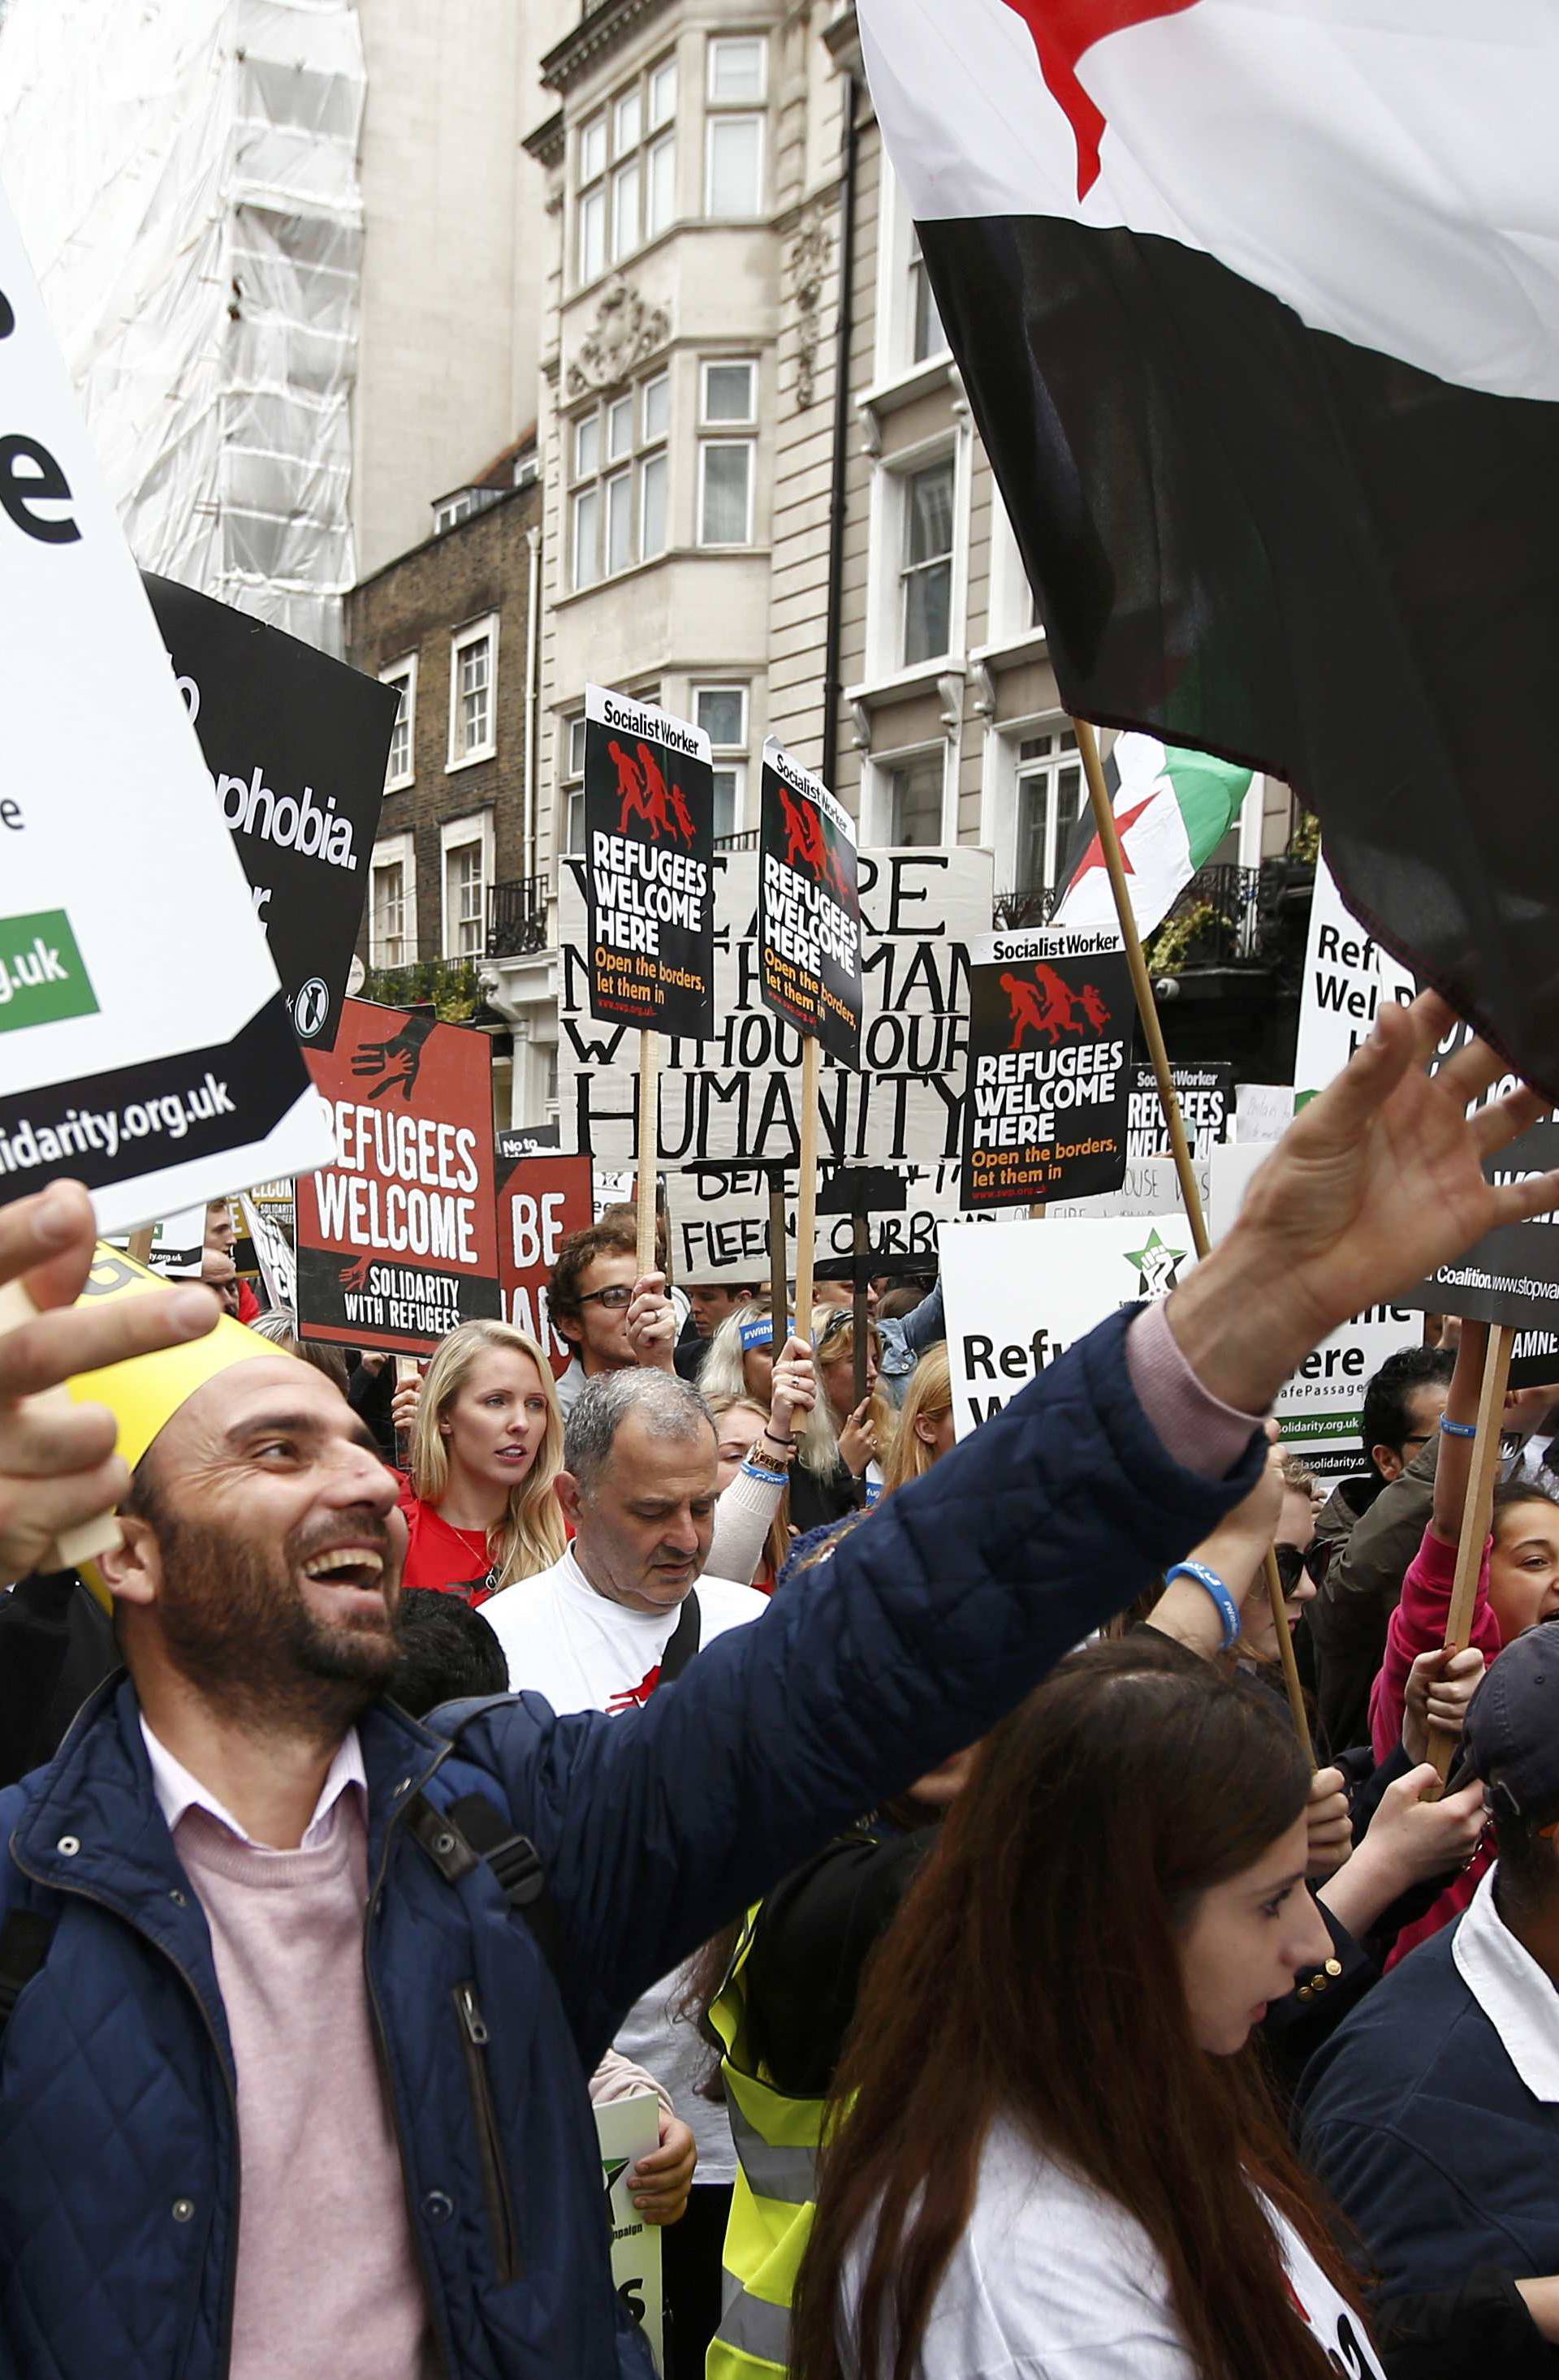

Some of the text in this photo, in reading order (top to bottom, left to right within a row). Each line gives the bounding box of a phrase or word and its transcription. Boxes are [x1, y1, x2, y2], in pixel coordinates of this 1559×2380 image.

[593, 830, 706, 897] REFUGEES
[593, 868, 702, 933] WELCOME
[765, 853, 857, 951] REFUGEES
[595, 907, 659, 956] HERE
[763, 883, 855, 979] WELCOME
[765, 915, 821, 977] HERE
[595, 946, 632, 973] Open
[636, 956, 656, 978] the
[659, 960, 706, 994] borders,
[597, 971, 664, 1005] let them in
[765, 948, 796, 981] Open
[800, 971, 818, 994] the
[821, 982, 857, 1031] borders,
[767, 967, 826, 1021] let them in
[976, 1041, 1124, 1086] REFUGEES
[574, 1070, 966, 1158] HUMANITY
[974, 1072, 1116, 1118] WELCOME
[0, 1072, 236, 1174] idarity.org.uk
[503, 1138, 538, 1153] No to
[973, 1112, 1055, 1148] HERE
[971, 1137, 1117, 1168] Open the borders,
[973, 1171, 995, 1188] let
[1000, 1168, 1043, 1184] them
[1047, 1164, 1062, 1180] in
[314, 1171, 478, 1264] WELCOME
[511, 1193, 566, 1267] BE
[369, 1265, 460, 1308] SOLIDARITY
[344, 1292, 461, 1334] WITH REFUGEES
